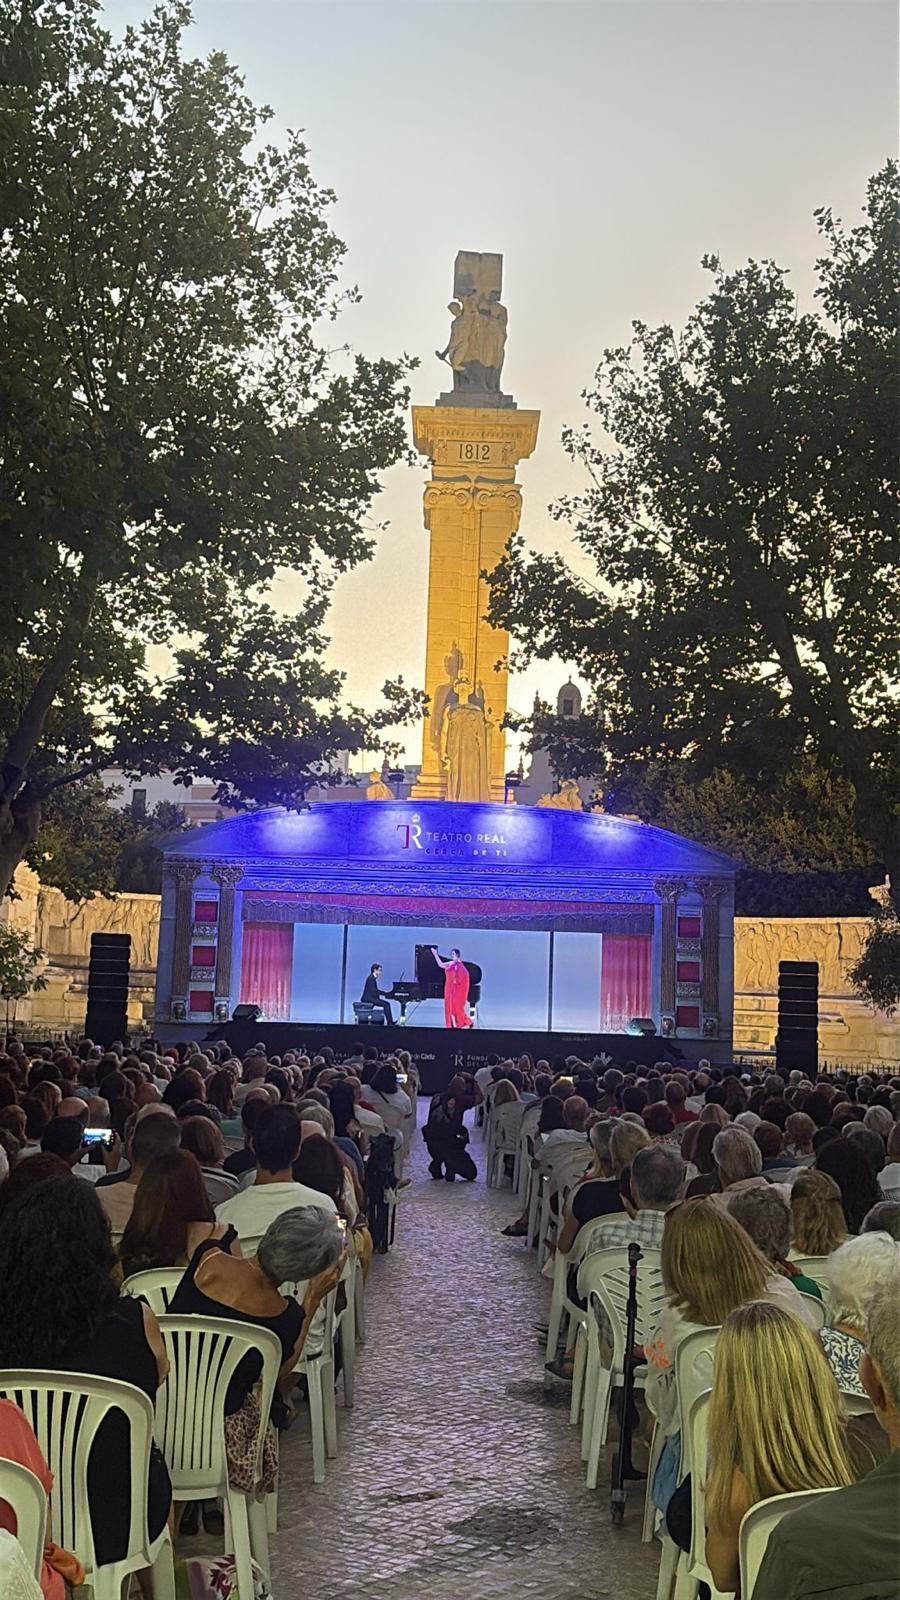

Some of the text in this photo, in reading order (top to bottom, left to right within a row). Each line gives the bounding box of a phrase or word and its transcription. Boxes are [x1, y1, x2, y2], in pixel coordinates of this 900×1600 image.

[459, 444, 490, 460] 1812
[426, 832, 507, 844] TEATRO REAL
[425, 848, 464, 856] CERCA
